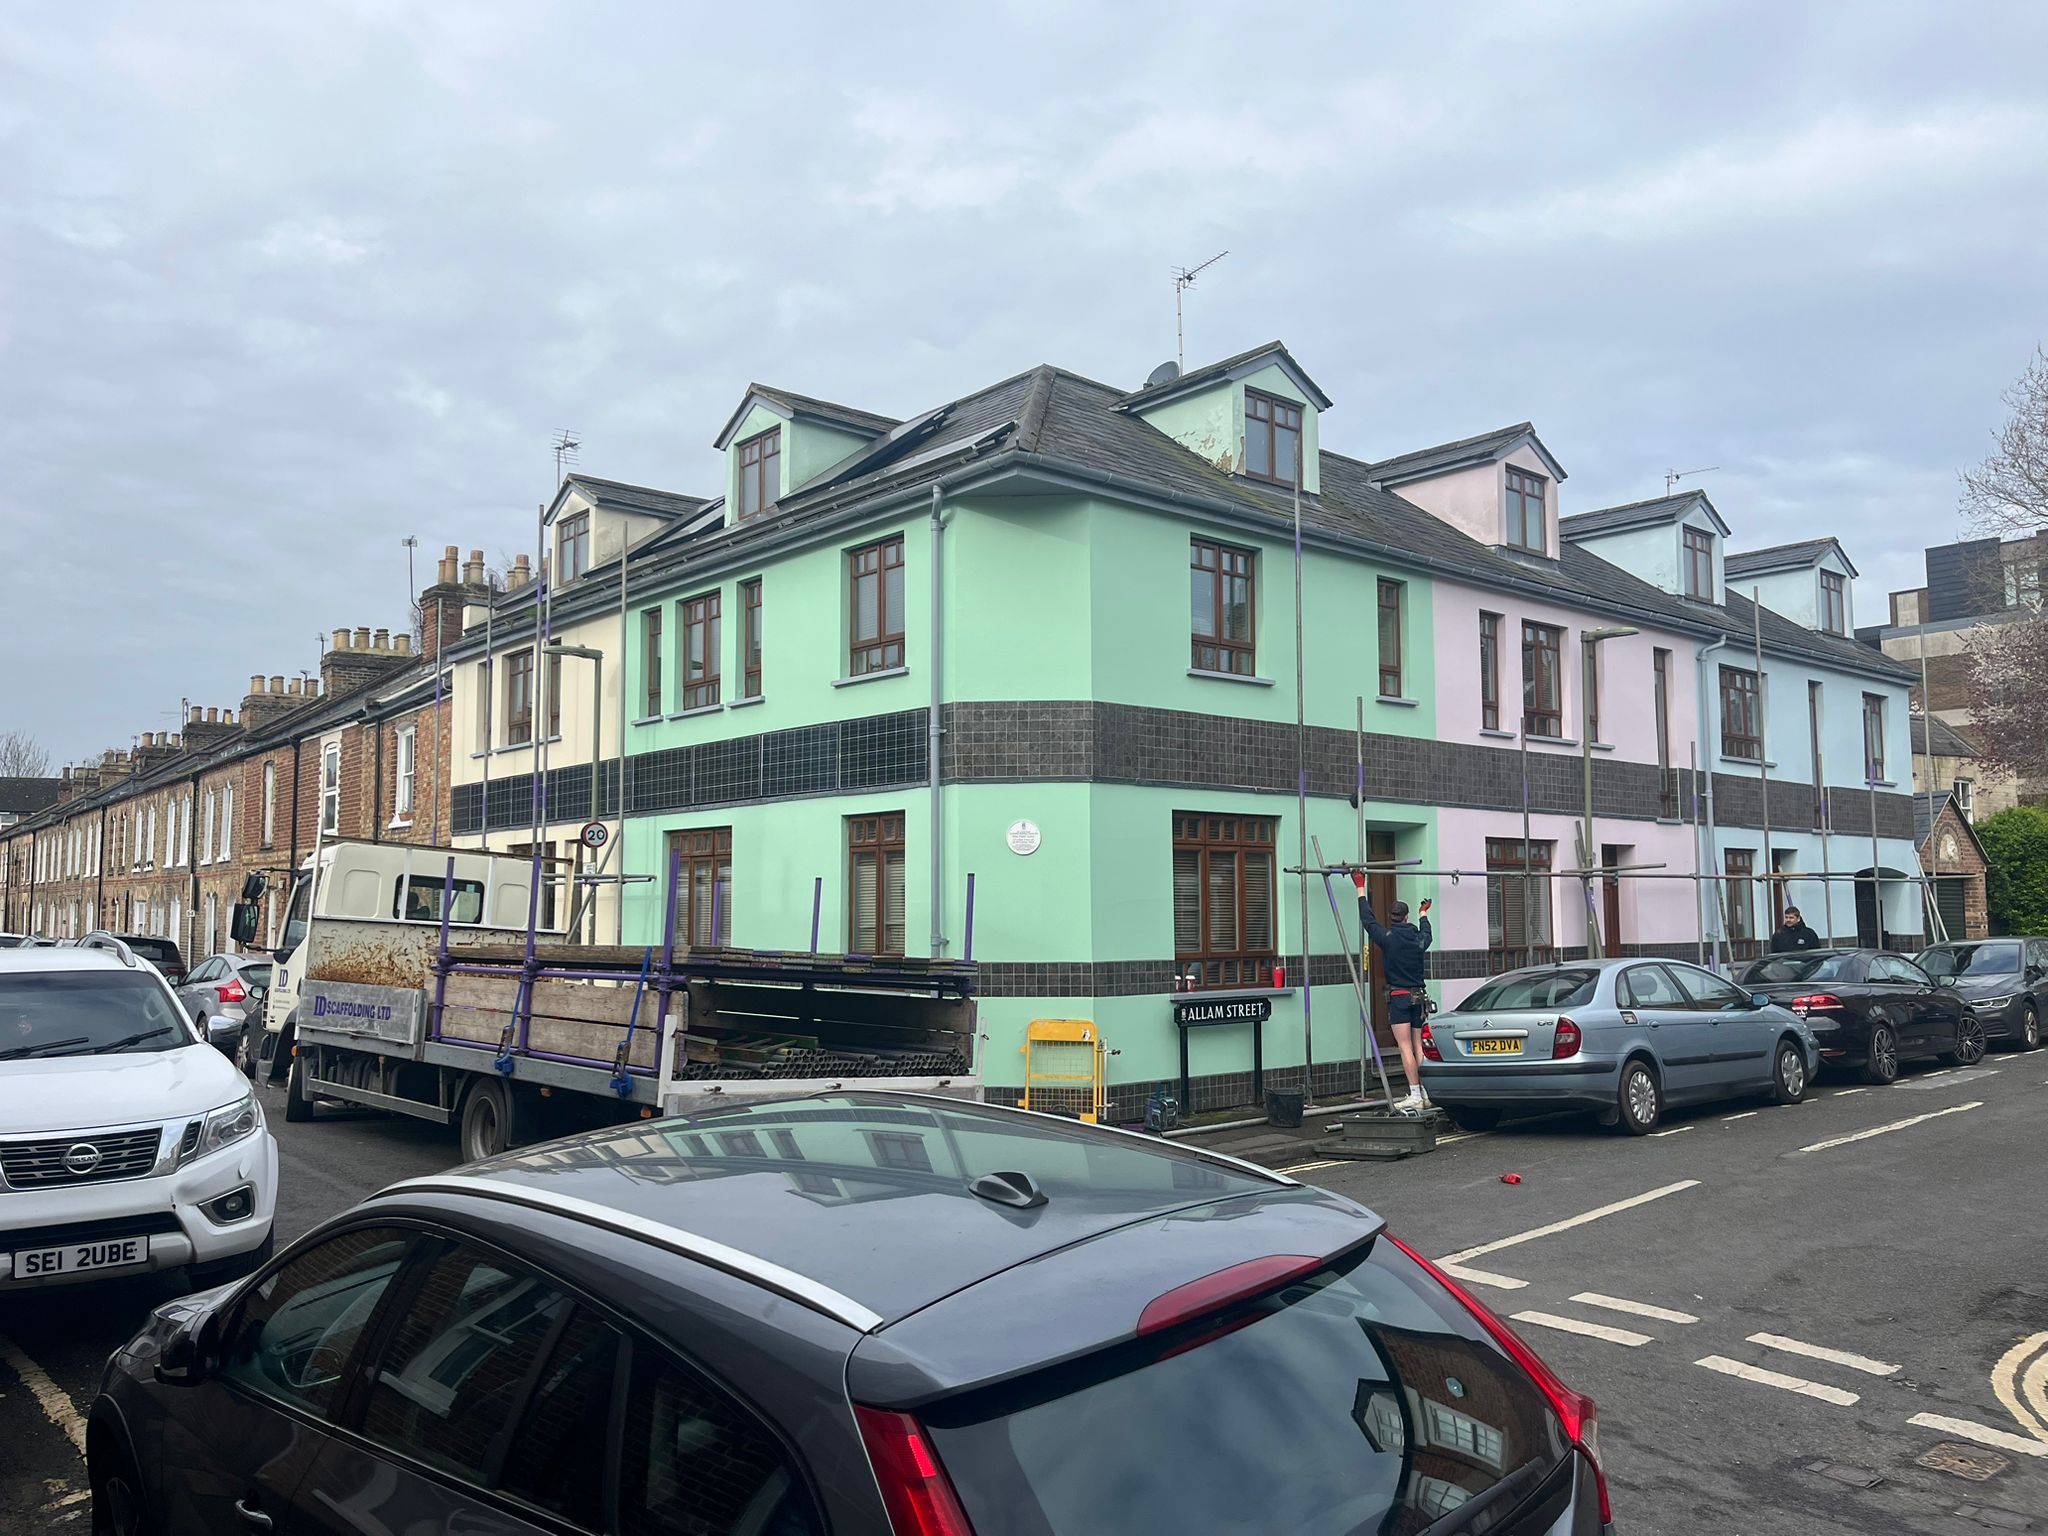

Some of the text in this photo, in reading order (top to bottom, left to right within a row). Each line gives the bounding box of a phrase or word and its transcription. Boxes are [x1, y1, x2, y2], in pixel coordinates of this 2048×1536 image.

[588, 829, 605, 841] 20
[326, 1000, 376, 1019] SCAFFOLDING
[376, 1005, 391, 1020] LTD
[1187, 1002, 1264, 1021] ALLAM STREET
[1472, 1039, 1520, 1052] FN52 DVA
[66, 1155, 98, 1164] NISSAN
[76, 1241, 137, 1268] 2UBE
